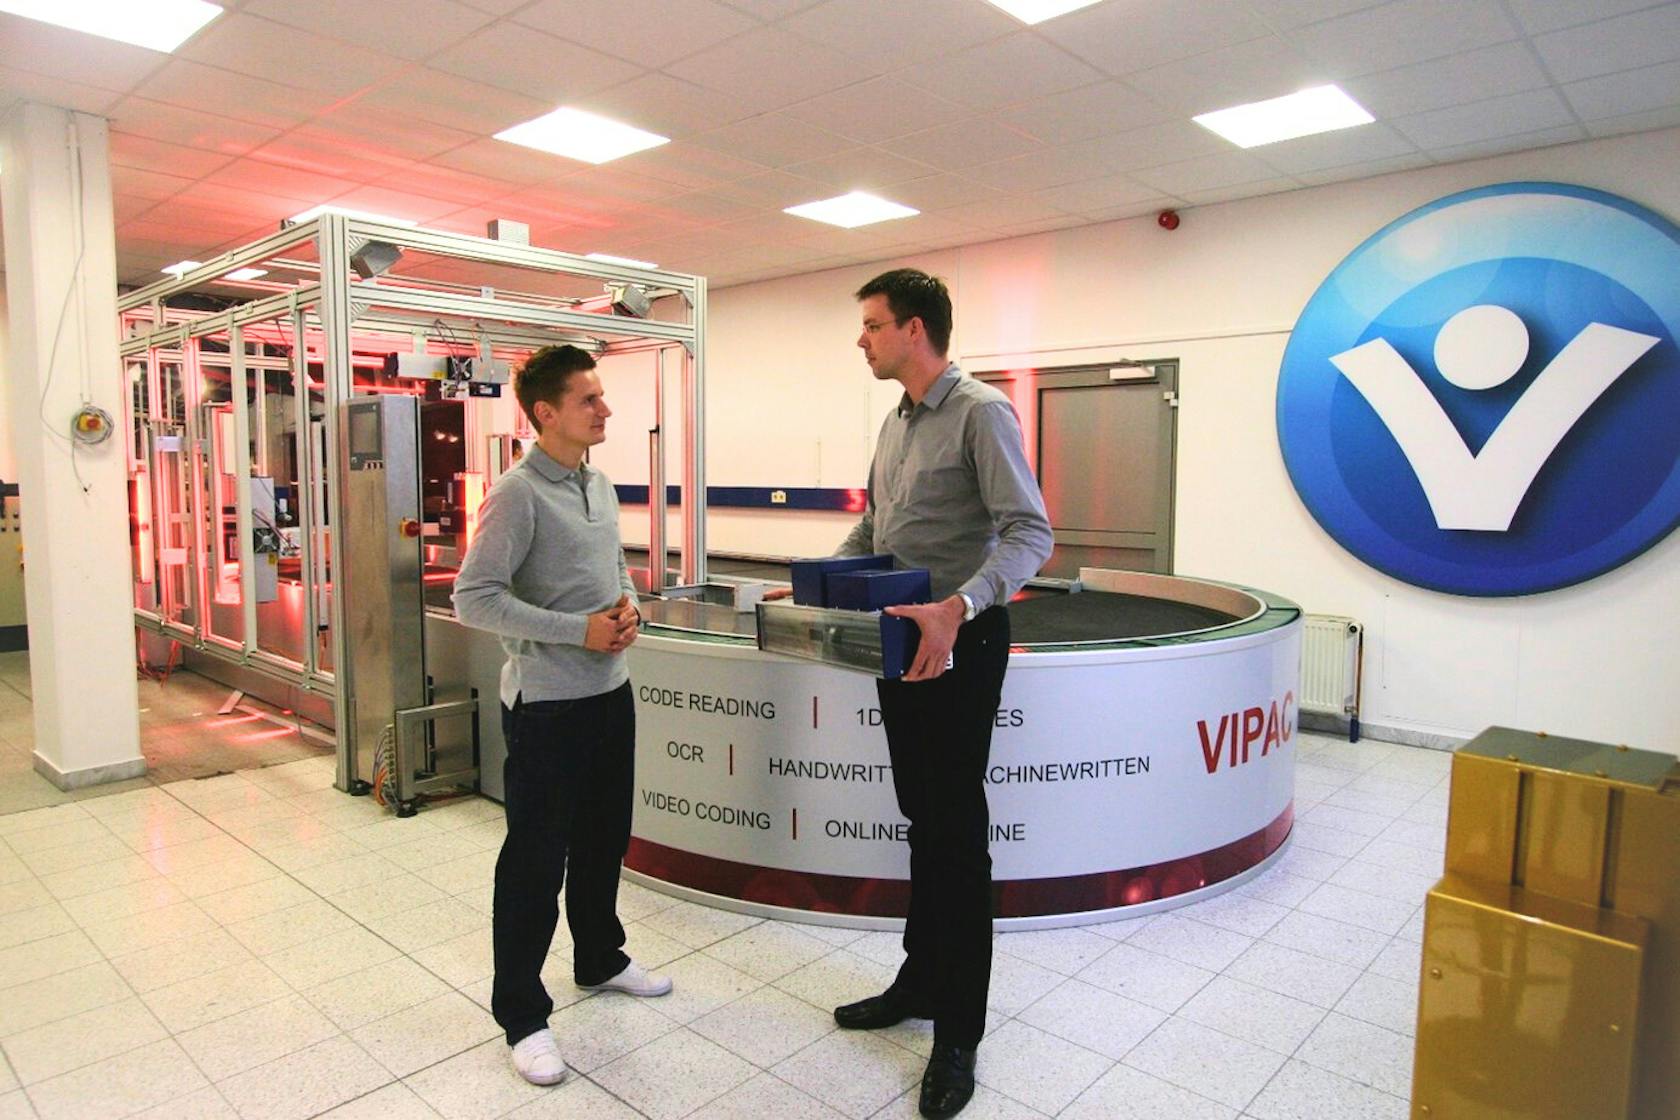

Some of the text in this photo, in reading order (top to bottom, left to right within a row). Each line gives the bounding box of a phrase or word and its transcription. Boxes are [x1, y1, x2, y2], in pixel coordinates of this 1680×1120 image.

[639, 685, 776, 719] CODE READING
[995, 708, 1024, 727] ES
[667, 741, 704, 763] OCR
[769, 756, 1150, 784] HANDWRIT CHINEWRITTEN
[642, 789, 771, 830] VIDEO CODING
[825, 819, 1026, 842] ONLINE INE
